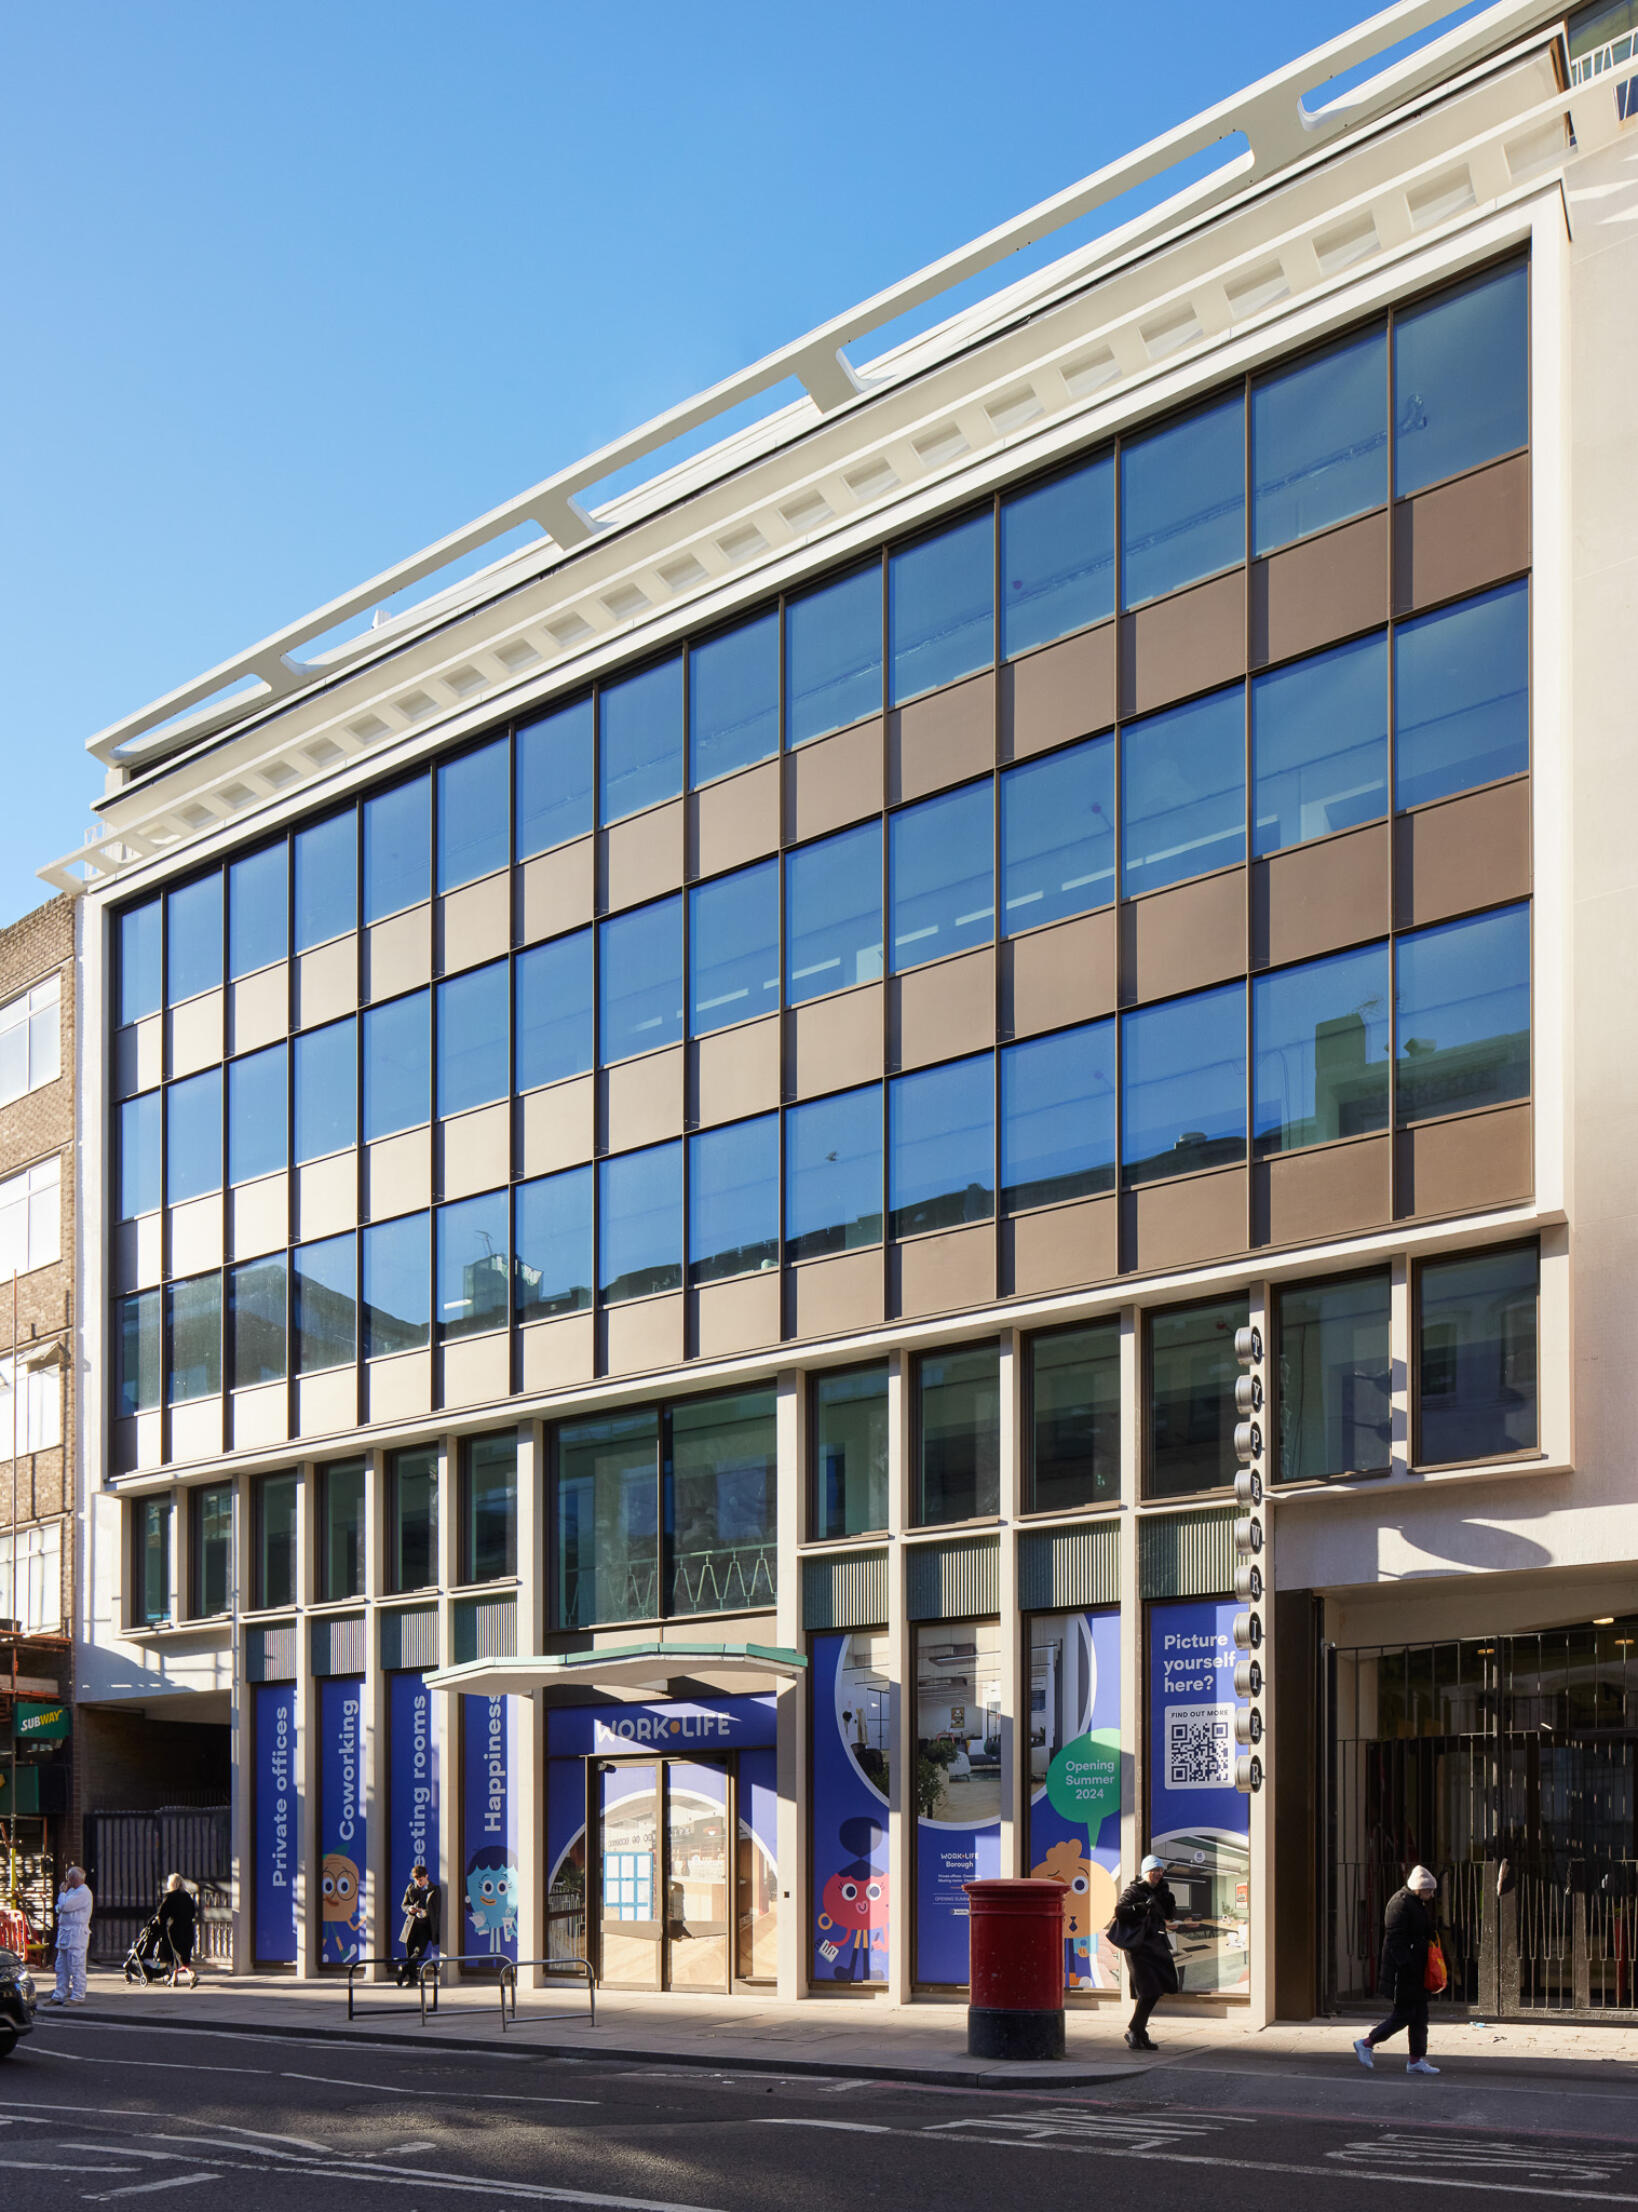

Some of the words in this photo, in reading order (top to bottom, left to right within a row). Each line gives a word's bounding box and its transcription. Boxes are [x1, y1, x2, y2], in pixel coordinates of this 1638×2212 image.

[1164, 1633, 1228, 1650] Picture
[1163, 1650, 1236, 1676] yourself
[1164, 1675, 1214, 1693] here?
[20, 1709, 63, 1732] SUBWAY
[1207, 1709, 1229, 1717] MORE
[412, 1695, 425, 1779] rooms
[271, 1706, 287, 1791] offices
[338, 1699, 359, 1841] Coworking
[1065, 1760, 1115, 1773] Opening
[1065, 1775, 1115, 1786] Summer
[1075, 1788, 1104, 1800] 2024
[409, 1786, 430, 1867] eeting
[272, 1798, 287, 1887] Private
[945, 1861, 974, 1869] Borough
